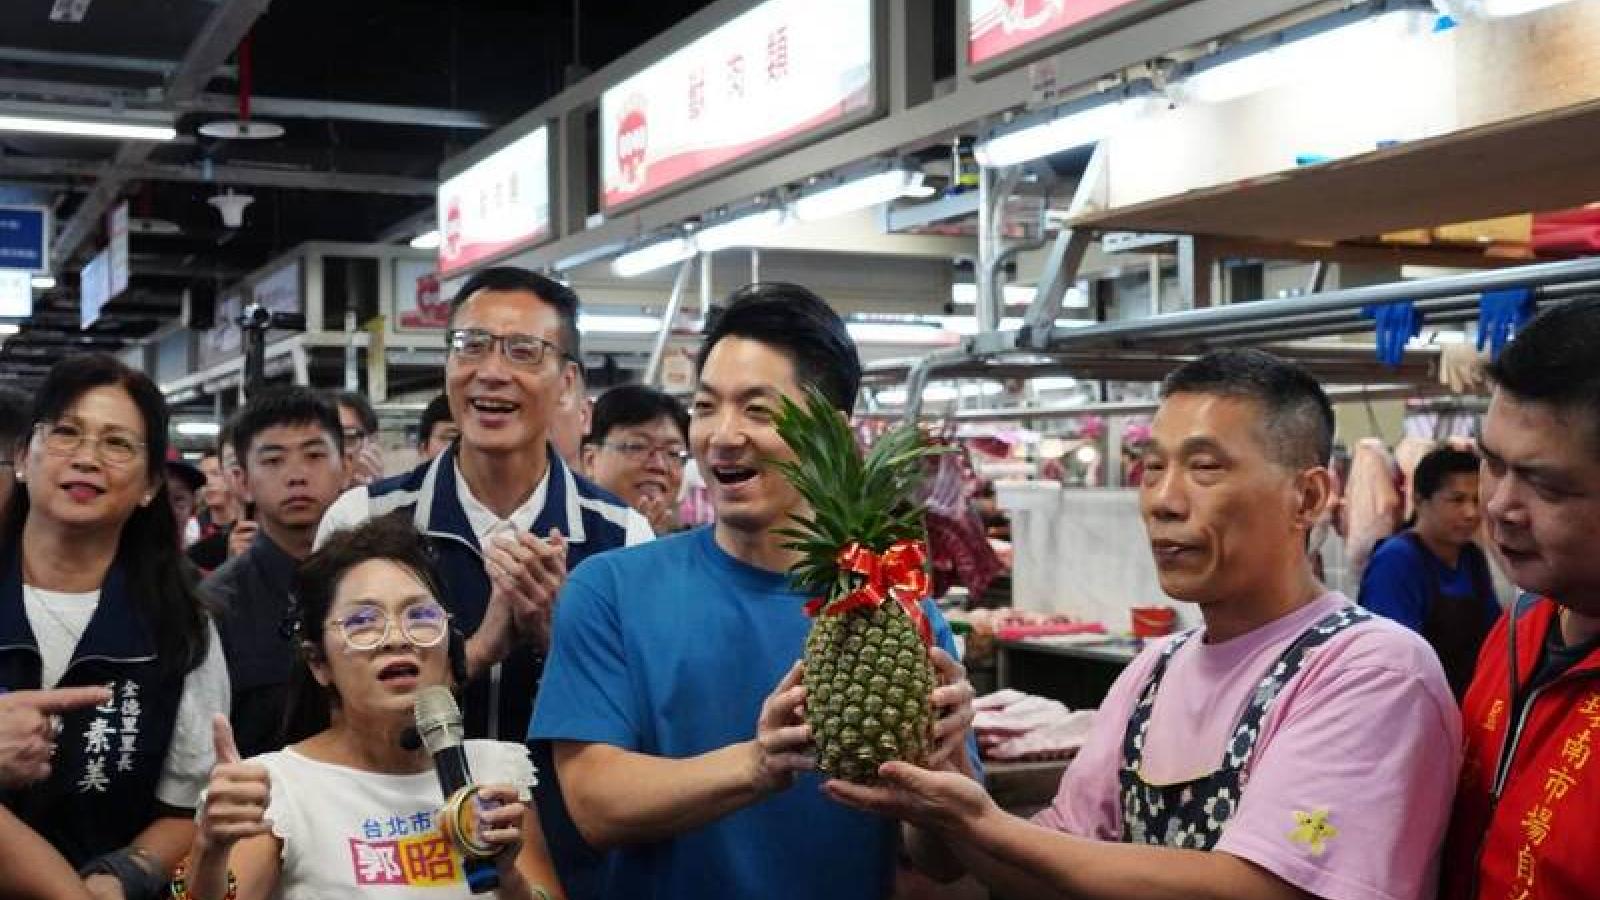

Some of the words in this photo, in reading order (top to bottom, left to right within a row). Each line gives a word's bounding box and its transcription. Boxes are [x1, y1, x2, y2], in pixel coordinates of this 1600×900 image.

[362, 810, 432, 839] 台北市
[354, 838, 456, 882] 郭昭
